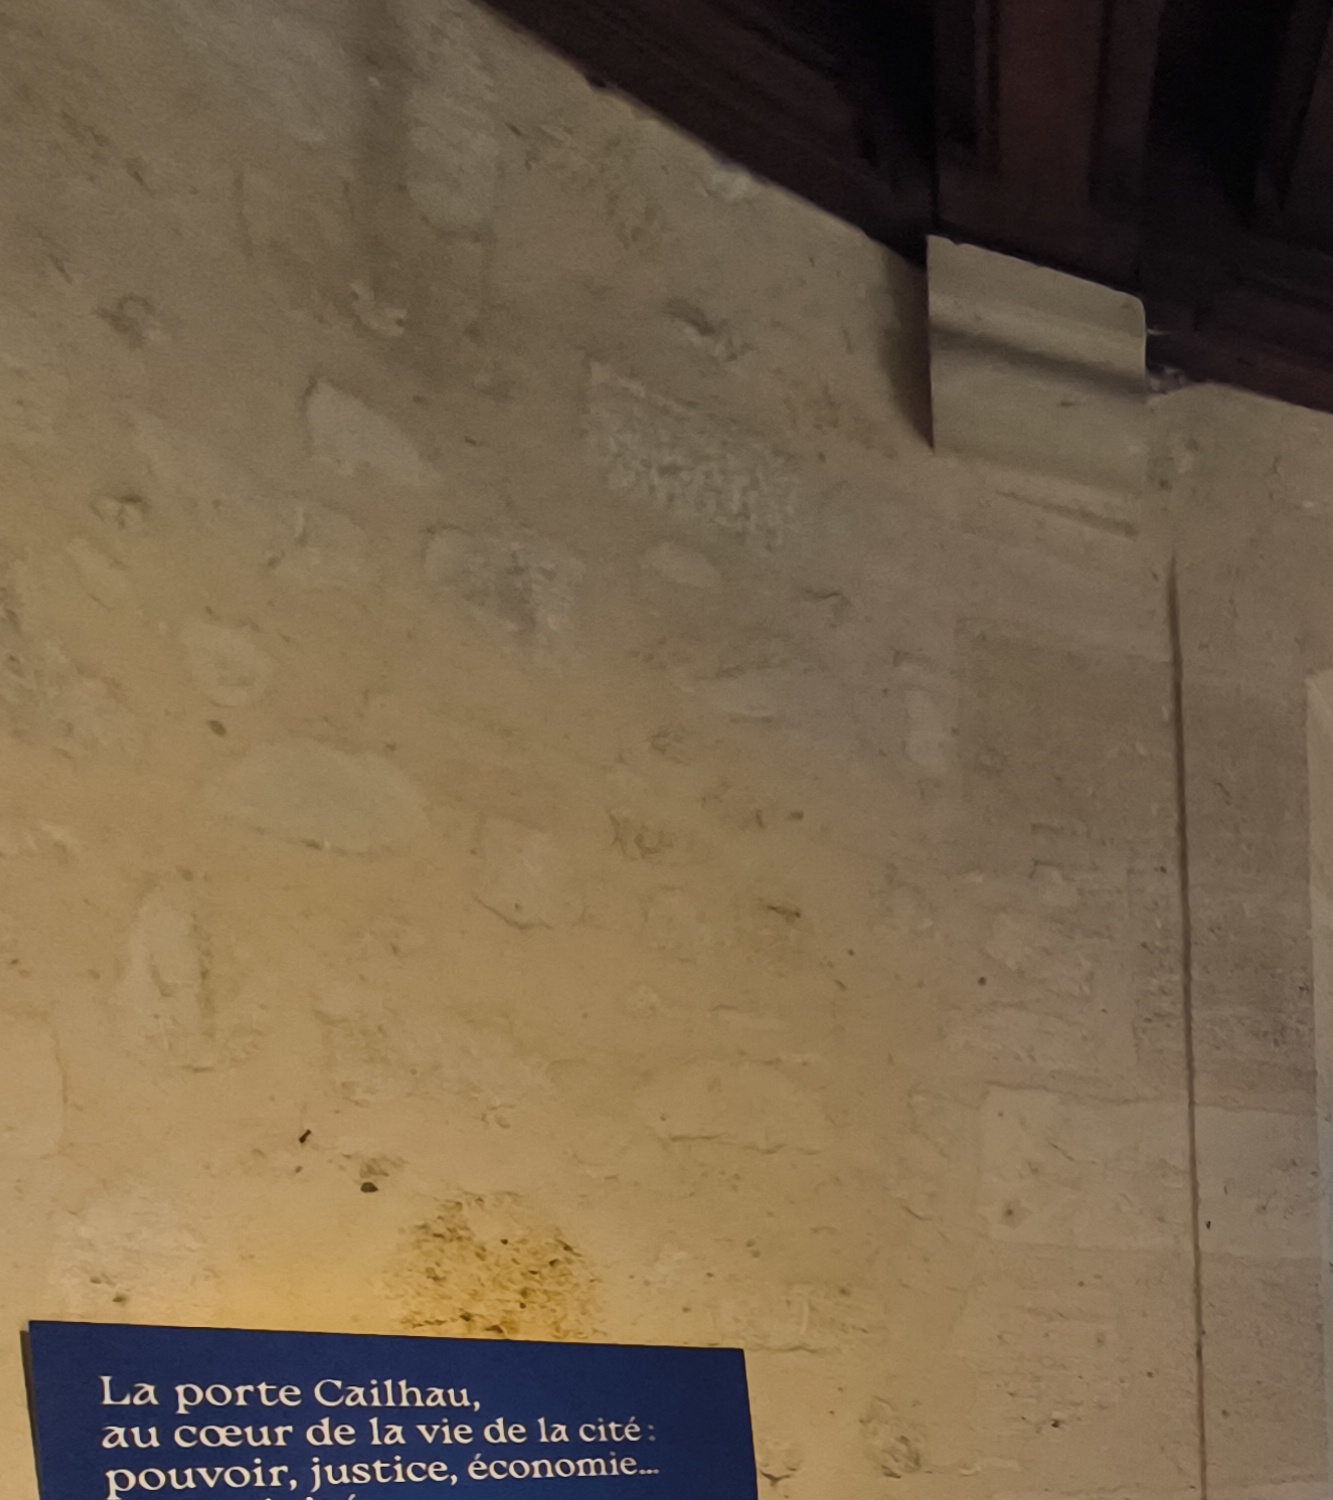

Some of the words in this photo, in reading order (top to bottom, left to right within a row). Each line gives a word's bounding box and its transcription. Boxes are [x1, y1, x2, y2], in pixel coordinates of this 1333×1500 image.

[101, 1375, 158, 1406] La
[174, 1379, 302, 1415] porte
[313, 1378, 482, 1412] Cailhau,
[101, 1425, 161, 1449] au
[174, 1425, 294, 1448] cœur
[305, 1416, 356, 1446] de
[368, 1416, 406, 1445] la
[415, 1417, 474, 1445] vie
[483, 1416, 527, 1444] de
[537, 1416, 570, 1443] la
[105, 1457, 299, 1500] pouvoir,
[310, 1455, 459, 1493] justice,
